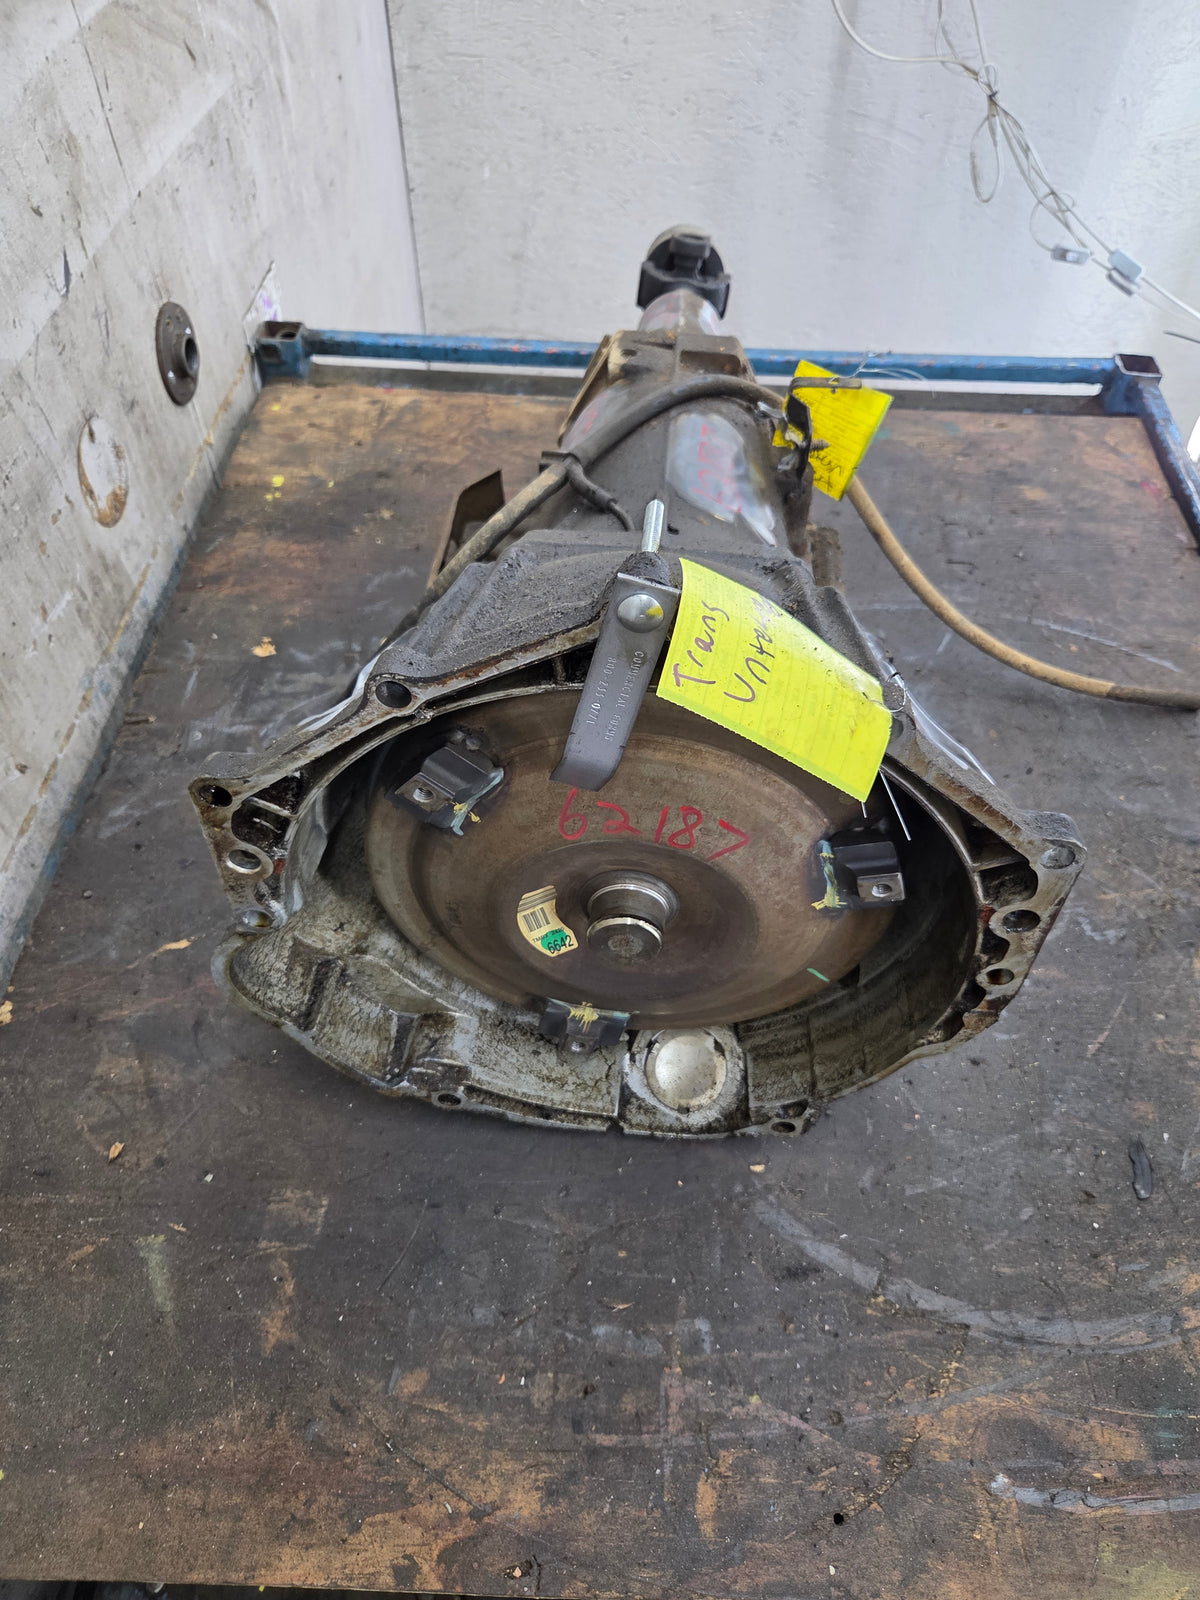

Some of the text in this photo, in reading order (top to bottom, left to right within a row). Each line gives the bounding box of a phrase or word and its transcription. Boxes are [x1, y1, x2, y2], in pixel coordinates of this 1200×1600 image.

[672, 600, 730, 687] Trans
[615, 650, 645, 708] COMMERCIAL
[547, 934, 575, 954] 6642
